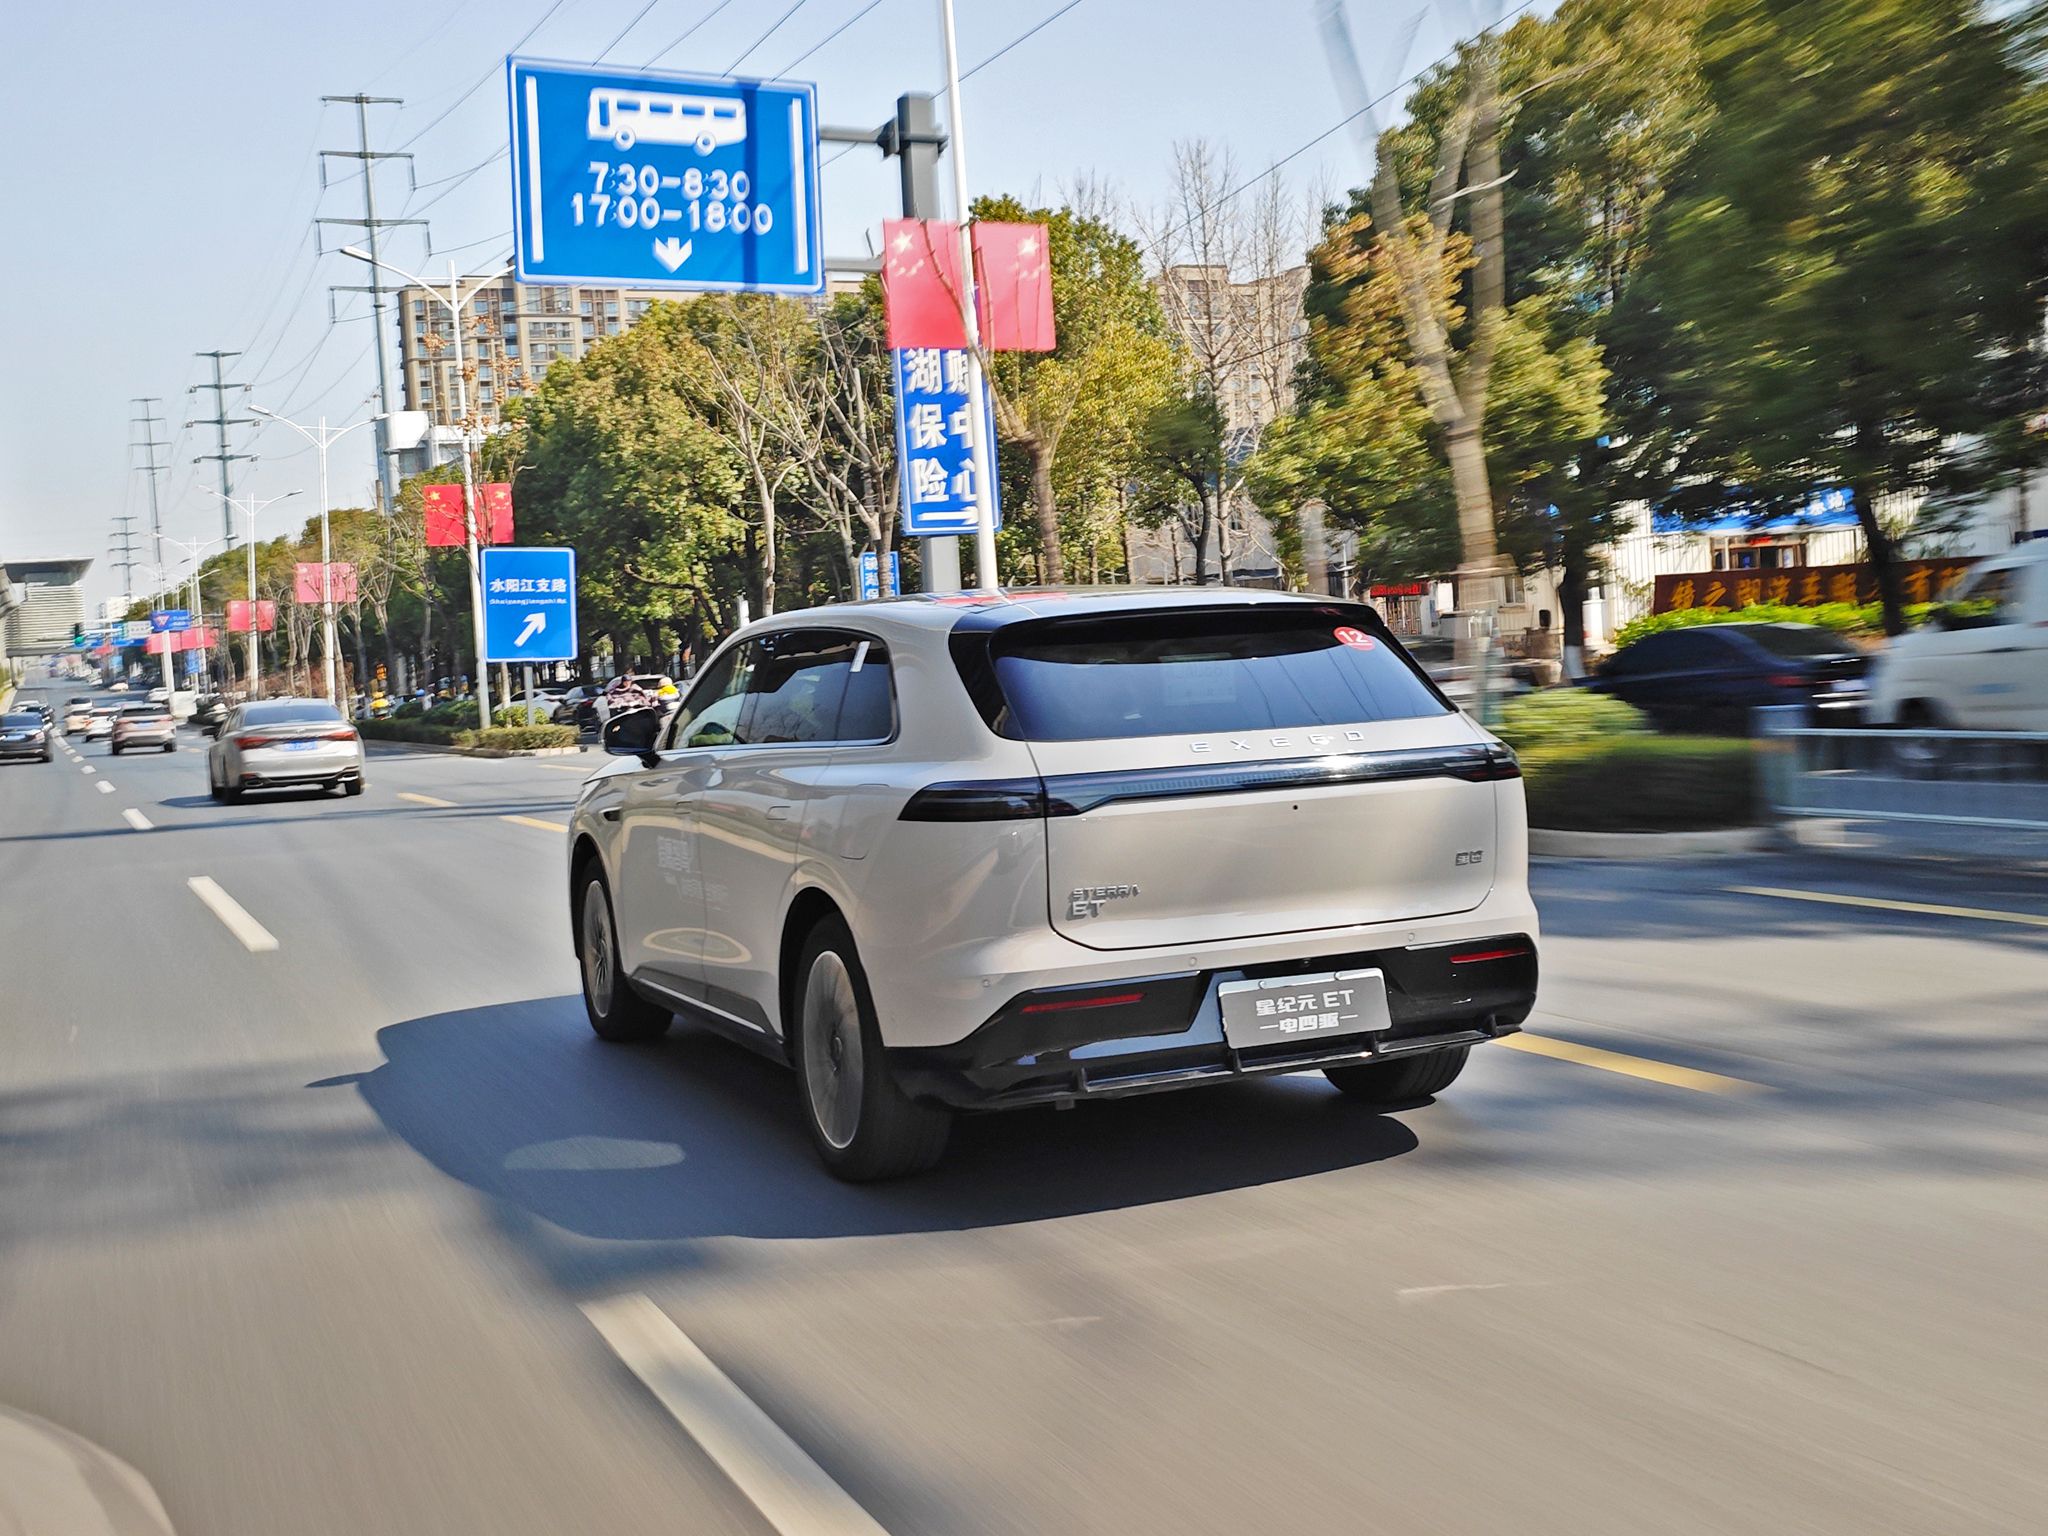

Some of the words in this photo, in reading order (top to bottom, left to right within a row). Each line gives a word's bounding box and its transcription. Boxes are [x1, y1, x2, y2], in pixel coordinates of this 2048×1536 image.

[588, 161, 750, 202] 7:30-8:30
[571, 192, 774, 236] 17:00-18:00
[489, 578, 567, 593] 水阳江支路
[1338, 630, 1369, 643] 12
[1190, 730, 1364, 753] EXEED
[1071, 900, 1107, 917] ET
[1255, 993, 1319, 1017] 星纪元
[1322, 989, 1354, 1008] ET
